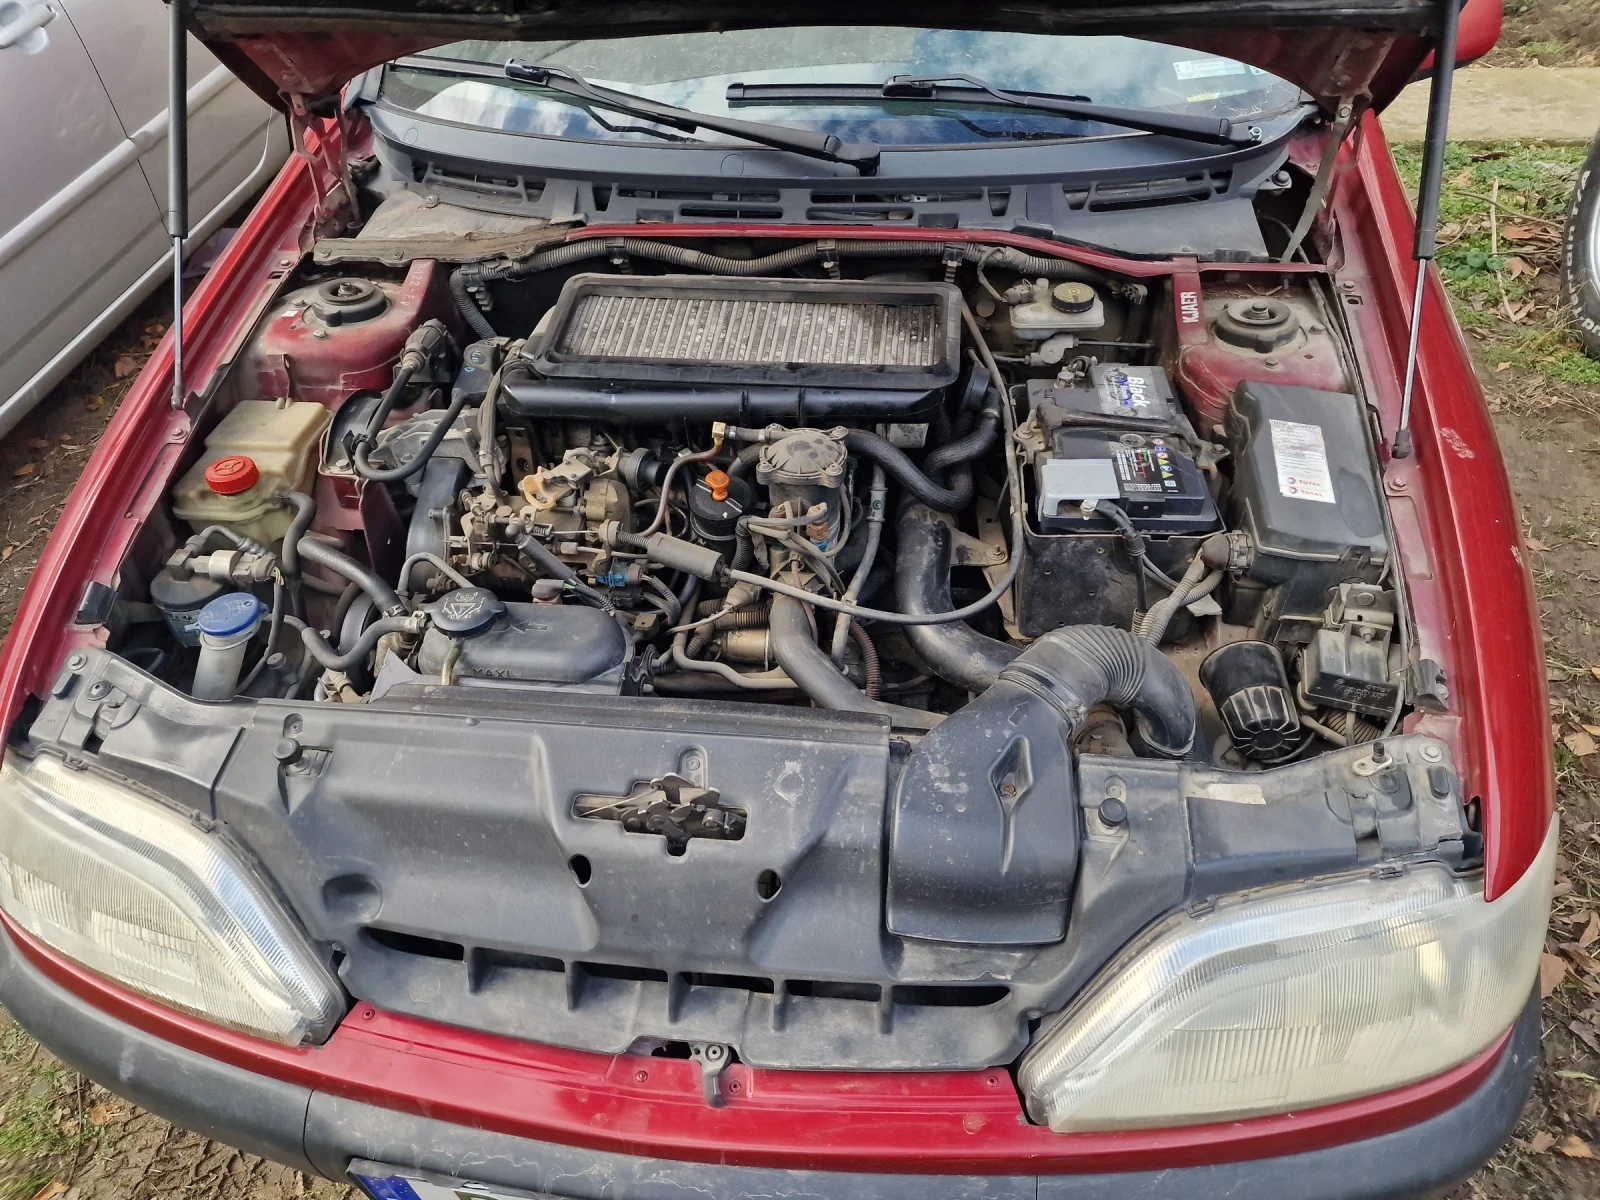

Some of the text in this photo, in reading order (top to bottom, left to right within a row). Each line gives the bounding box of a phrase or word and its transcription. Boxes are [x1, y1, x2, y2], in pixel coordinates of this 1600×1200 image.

[1180, 291, 1200, 324] KJAER
[1126, 376, 1151, 408] Black
[1299, 479, 1322, 487] TOTAL
[1300, 489, 1325, 498] TOTAL
